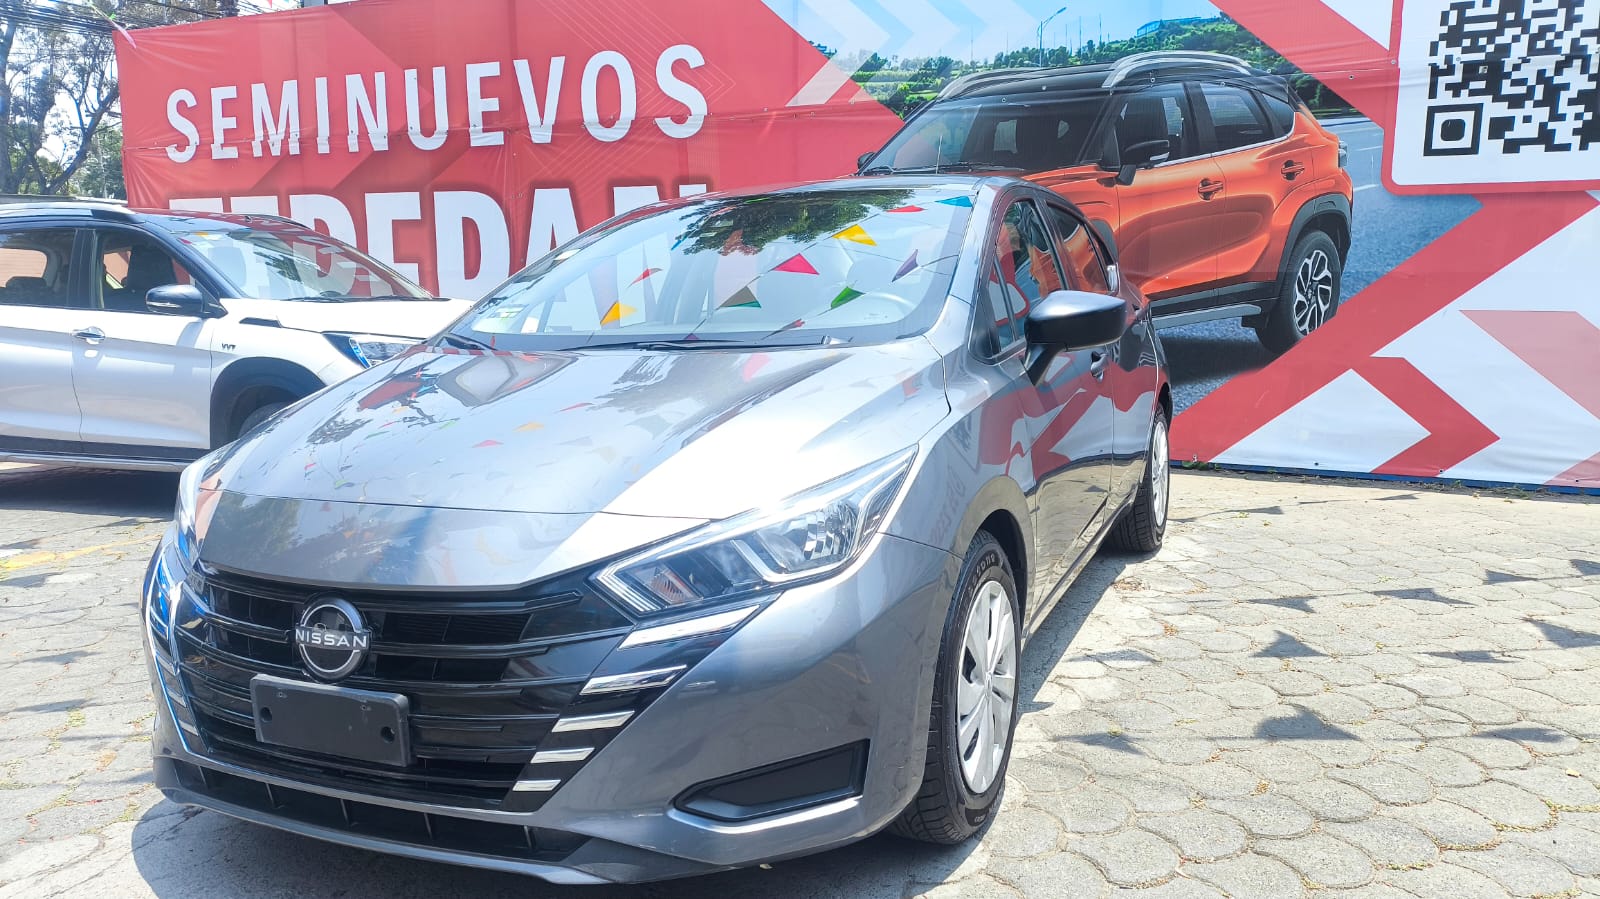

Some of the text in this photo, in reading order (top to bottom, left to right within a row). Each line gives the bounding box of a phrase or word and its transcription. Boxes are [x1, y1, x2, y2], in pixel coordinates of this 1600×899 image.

[166, 44, 708, 163] SEMINUEVOS
[168, 184, 708, 312] PEPAN
[295, 628, 367, 647] NISSAN
